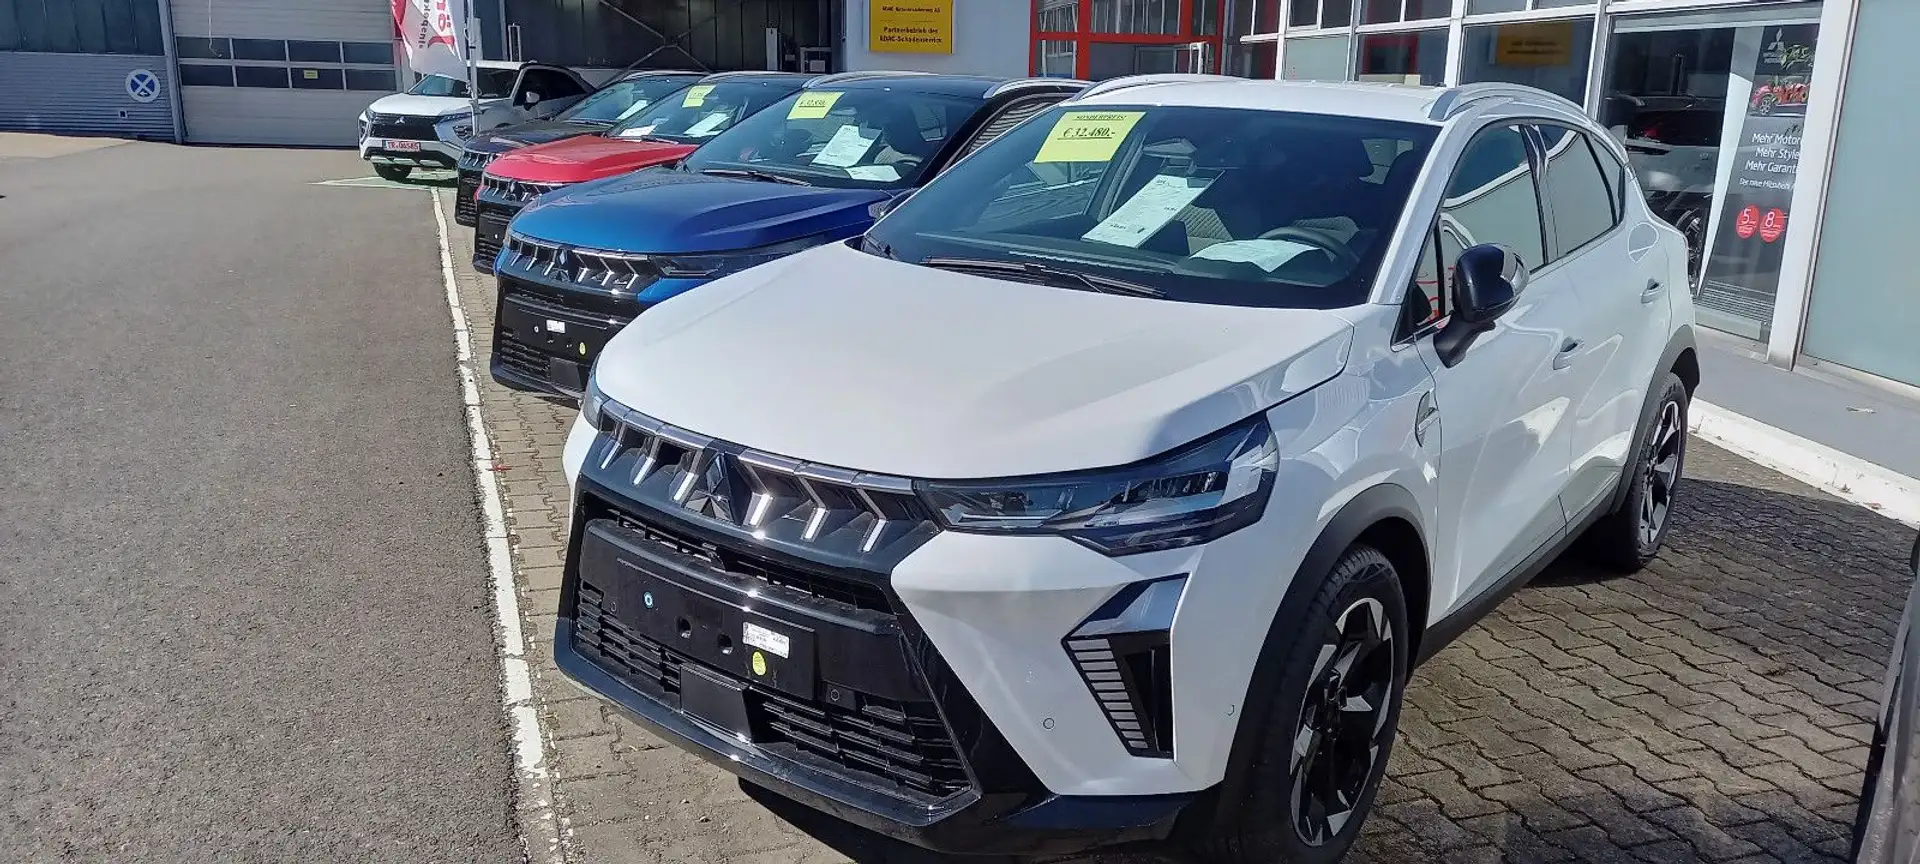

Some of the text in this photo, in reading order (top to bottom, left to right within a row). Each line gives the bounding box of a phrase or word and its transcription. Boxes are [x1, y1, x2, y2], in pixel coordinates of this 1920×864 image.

[883, 26, 928, 34] Partnerbetrieb
[1751, 133, 1774, 143] Mehr
[1755, 147, 1801, 162] Mehr Style
[1745, 160, 1799, 174] Mehr Garant
[1743, 208, 1775, 227] 5 8
